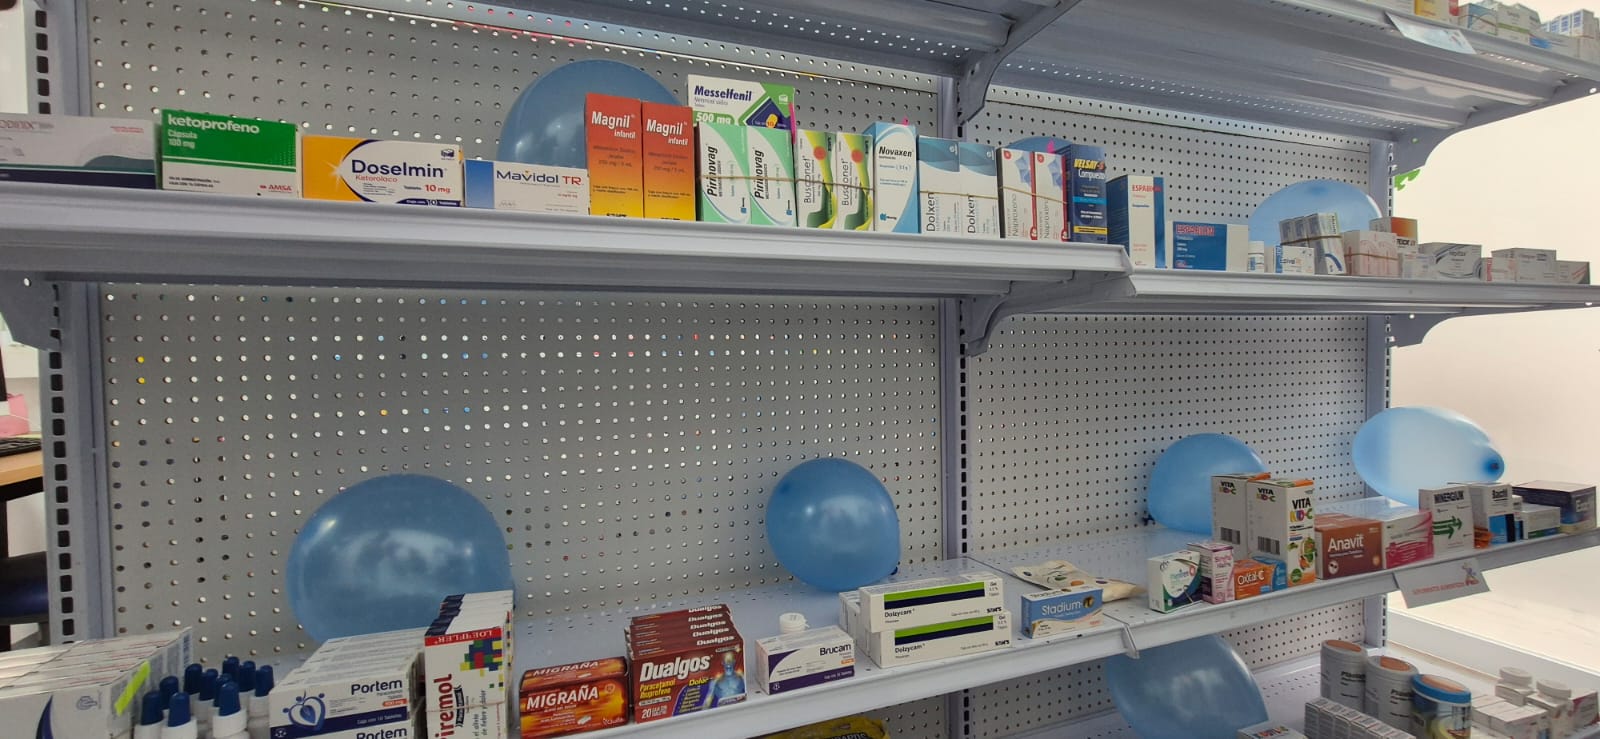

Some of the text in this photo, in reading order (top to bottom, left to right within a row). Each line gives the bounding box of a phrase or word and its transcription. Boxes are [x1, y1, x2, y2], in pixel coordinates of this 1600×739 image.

[694, 85, 752, 101] Messelfenil
[168, 114, 260, 134] ketoprofeno
[591, 111, 630, 129] Magnil
[696, 112, 732, 125] 500 mg
[614, 130, 636, 139] infantil
[646, 119, 683, 137] Magnil
[183, 141, 196, 149] mg
[668, 137, 688, 146] infantil
[879, 146, 912, 157] Novaxen
[352, 160, 443, 178] Doselmin
[356, 175, 398, 183] Ketorolaco
[497, 170, 559, 184] Mavidol
[562, 176, 582, 186] TR
[425, 184, 436, 192] 10
[926, 192, 936, 232] Dolxen
[966, 195, 976, 234] Dolxen
[1257, 487, 1274, 495] VITA
[1292, 497, 1311, 509] VITA
[1328, 534, 1364, 552] Anavit
[884, 609, 912, 618] Dolzycam
[1042, 601, 1081, 615] Stadium
[688, 613, 723, 622] Dualgos
[690, 621, 726, 629] Dualgos
[692, 628, 729, 637] Dualgos
[696, 636, 735, 645] Dualgos
[820, 644, 852, 656] Brucam
[895, 645, 922, 653] Dolzycam
[533, 661, 599, 676] MIGRAÑA
[640, 655, 711, 682] Dualgos
[351, 680, 402, 695] Portem
[640, 679, 676, 692] Paracetamol
[526, 685, 599, 710] MIGRAÑA
[433, 674, 455, 739] iremol
[642, 709, 651, 719] 20
